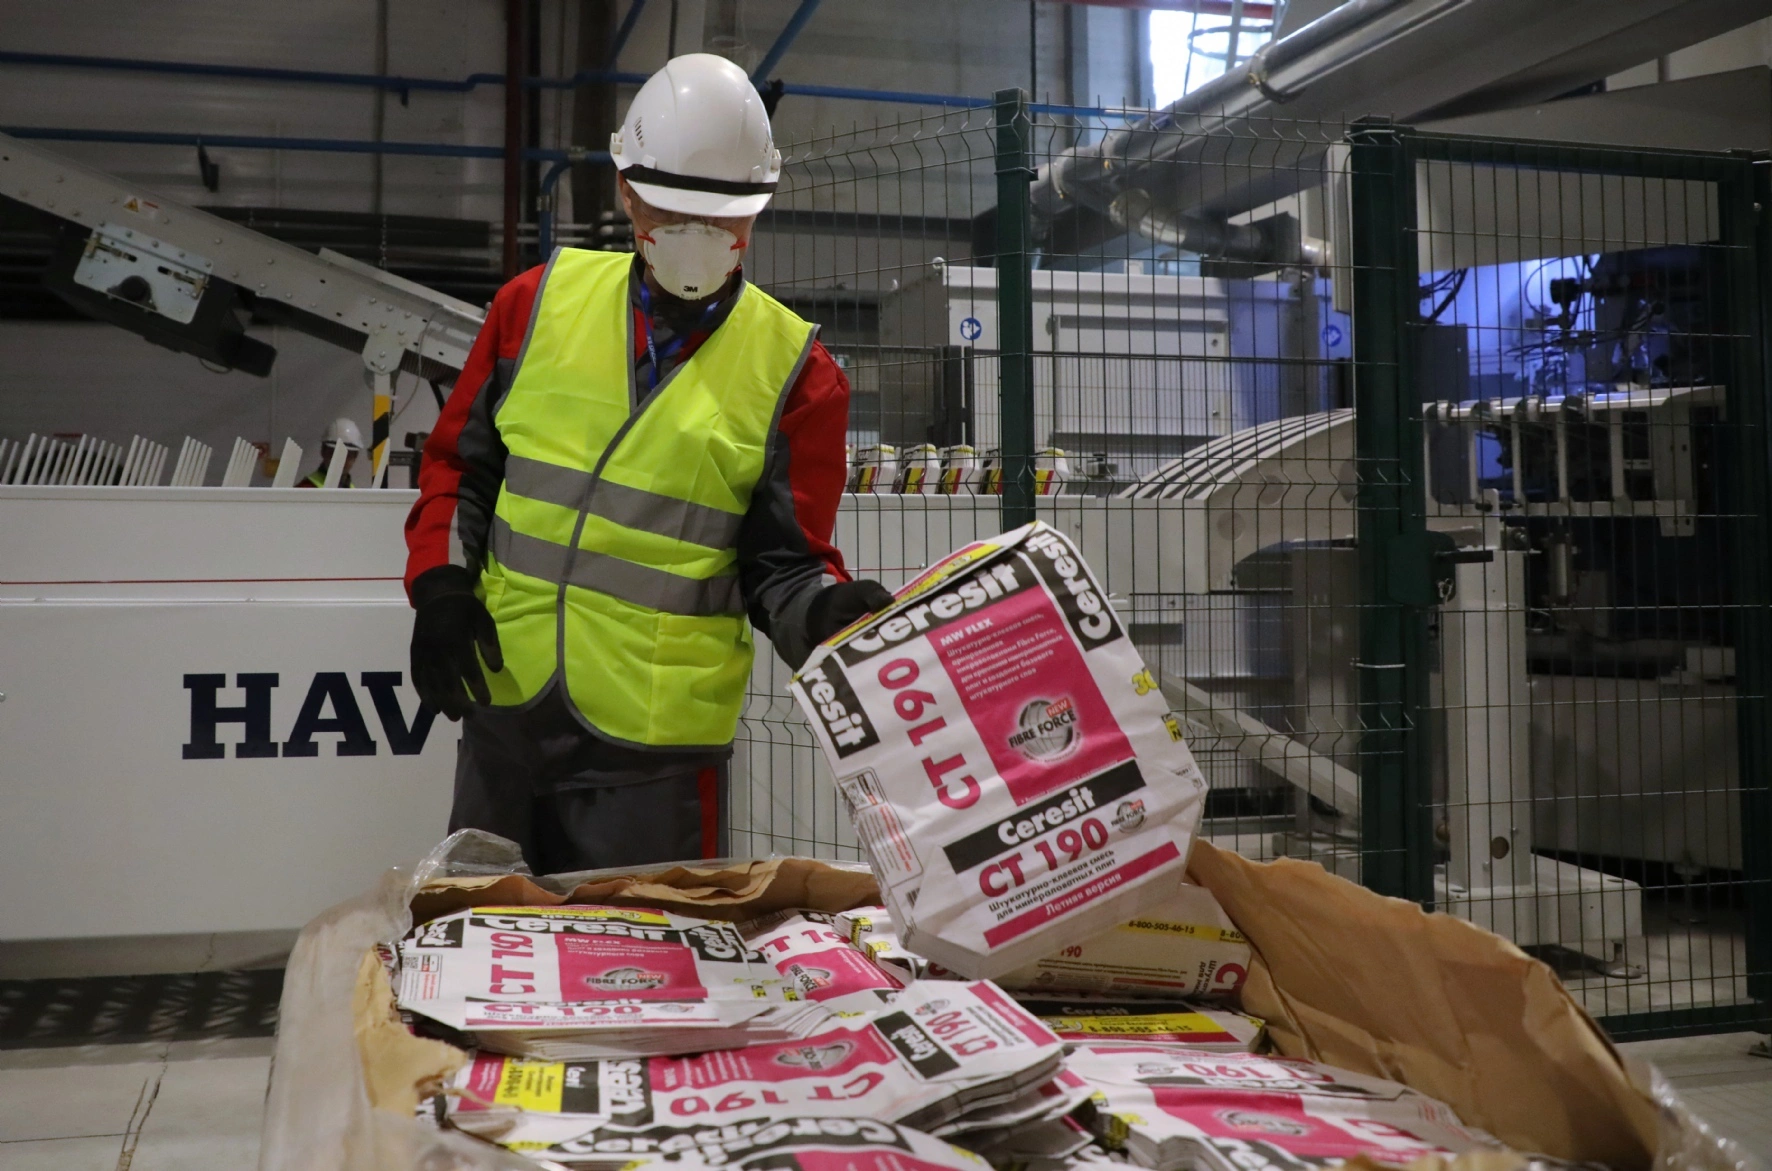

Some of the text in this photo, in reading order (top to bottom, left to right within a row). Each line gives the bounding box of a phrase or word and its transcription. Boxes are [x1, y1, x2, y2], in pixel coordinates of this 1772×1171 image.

[683, 285, 698, 293] 3M
[849, 563, 1020, 652] Ceresit
[1025, 532, 1112, 640] Ceresit
[940, 618, 994, 647] MW FLEX
[182, 671, 463, 760] HAV
[878, 657, 947, 748] 190
[1047, 700, 1069, 716] NEW
[1008, 730, 1037, 748] FIBRE
[1037, 709, 1077, 735] FORCE
[921, 752, 981, 810] CT
[998, 786, 1096, 846] Ceresit
[979, 817, 1109, 898] CT 190
[988, 849, 1114, 913] Штукатурно-клеевая смесь
[996, 857, 1116, 921] для минераловатных плит
[1045, 872, 1122, 916] Летняя версия
[484, 918, 667, 941] Ceresit
[586, 977, 616, 985] FIBRE
[557, 1005, 643, 1016] 190
[925, 1010, 978, 1042] 190
[1183, 1062, 1273, 1079] 190
